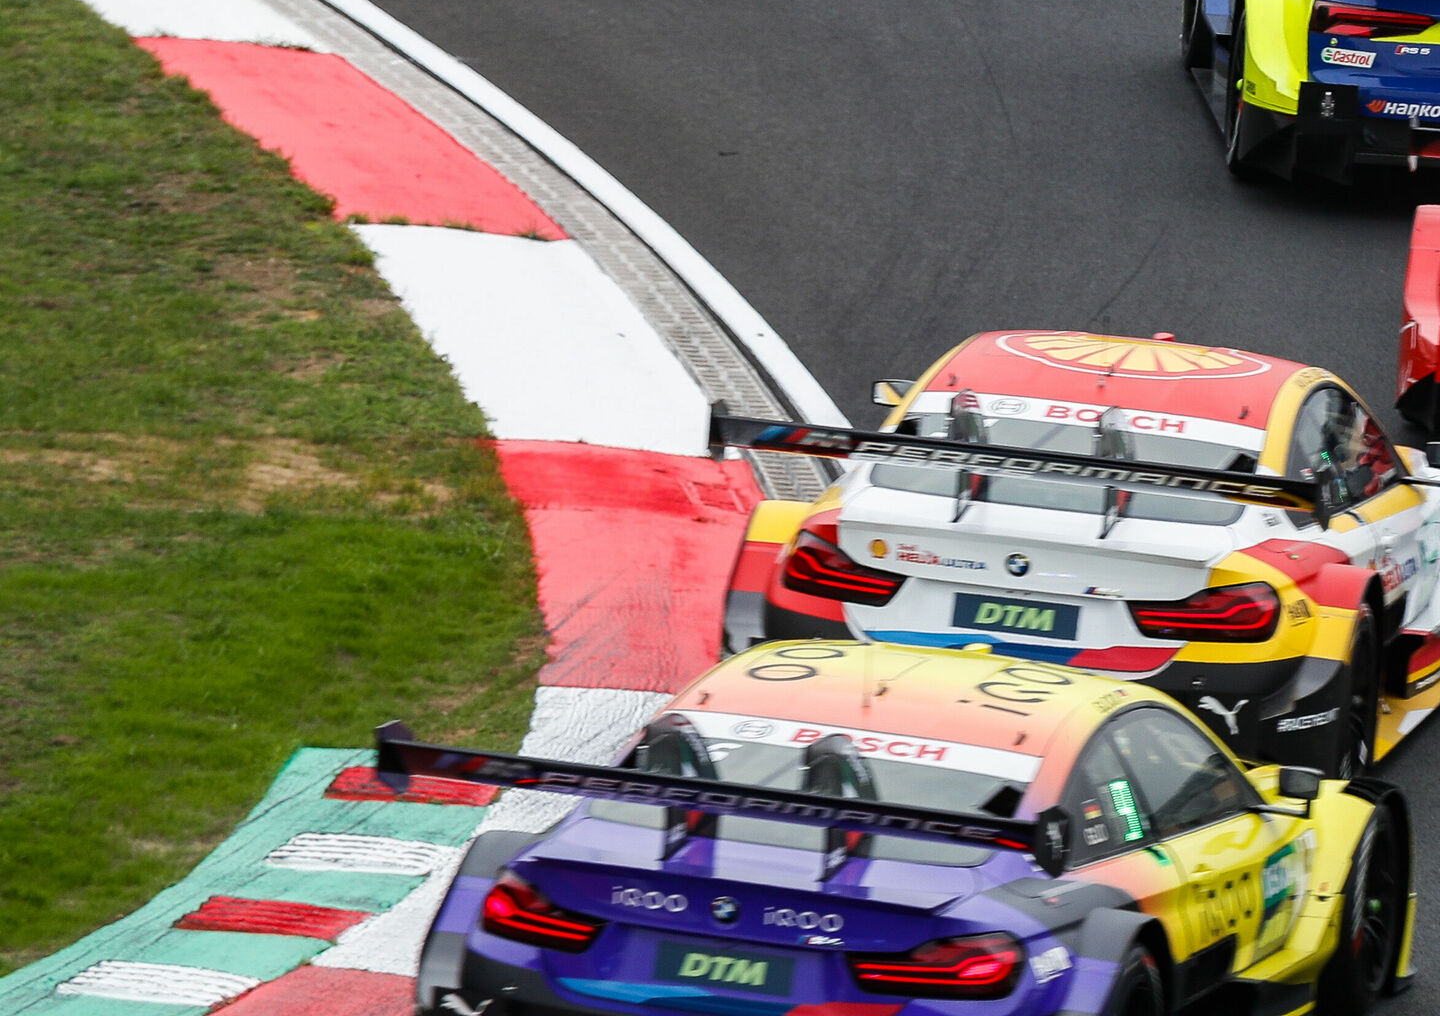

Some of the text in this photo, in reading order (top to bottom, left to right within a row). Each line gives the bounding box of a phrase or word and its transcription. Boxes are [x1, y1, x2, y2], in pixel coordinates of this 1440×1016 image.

[1332, 50, 1372, 66] Castrol
[1045, 404, 1186, 433] BOCH
[854, 441, 1284, 498] PERFORMANCE
[973, 602, 1056, 632] DTM
[790, 728, 950, 762] BSCH
[540, 771, 1002, 841] PERFORMANCE
[677, 952, 769, 986] DTM
